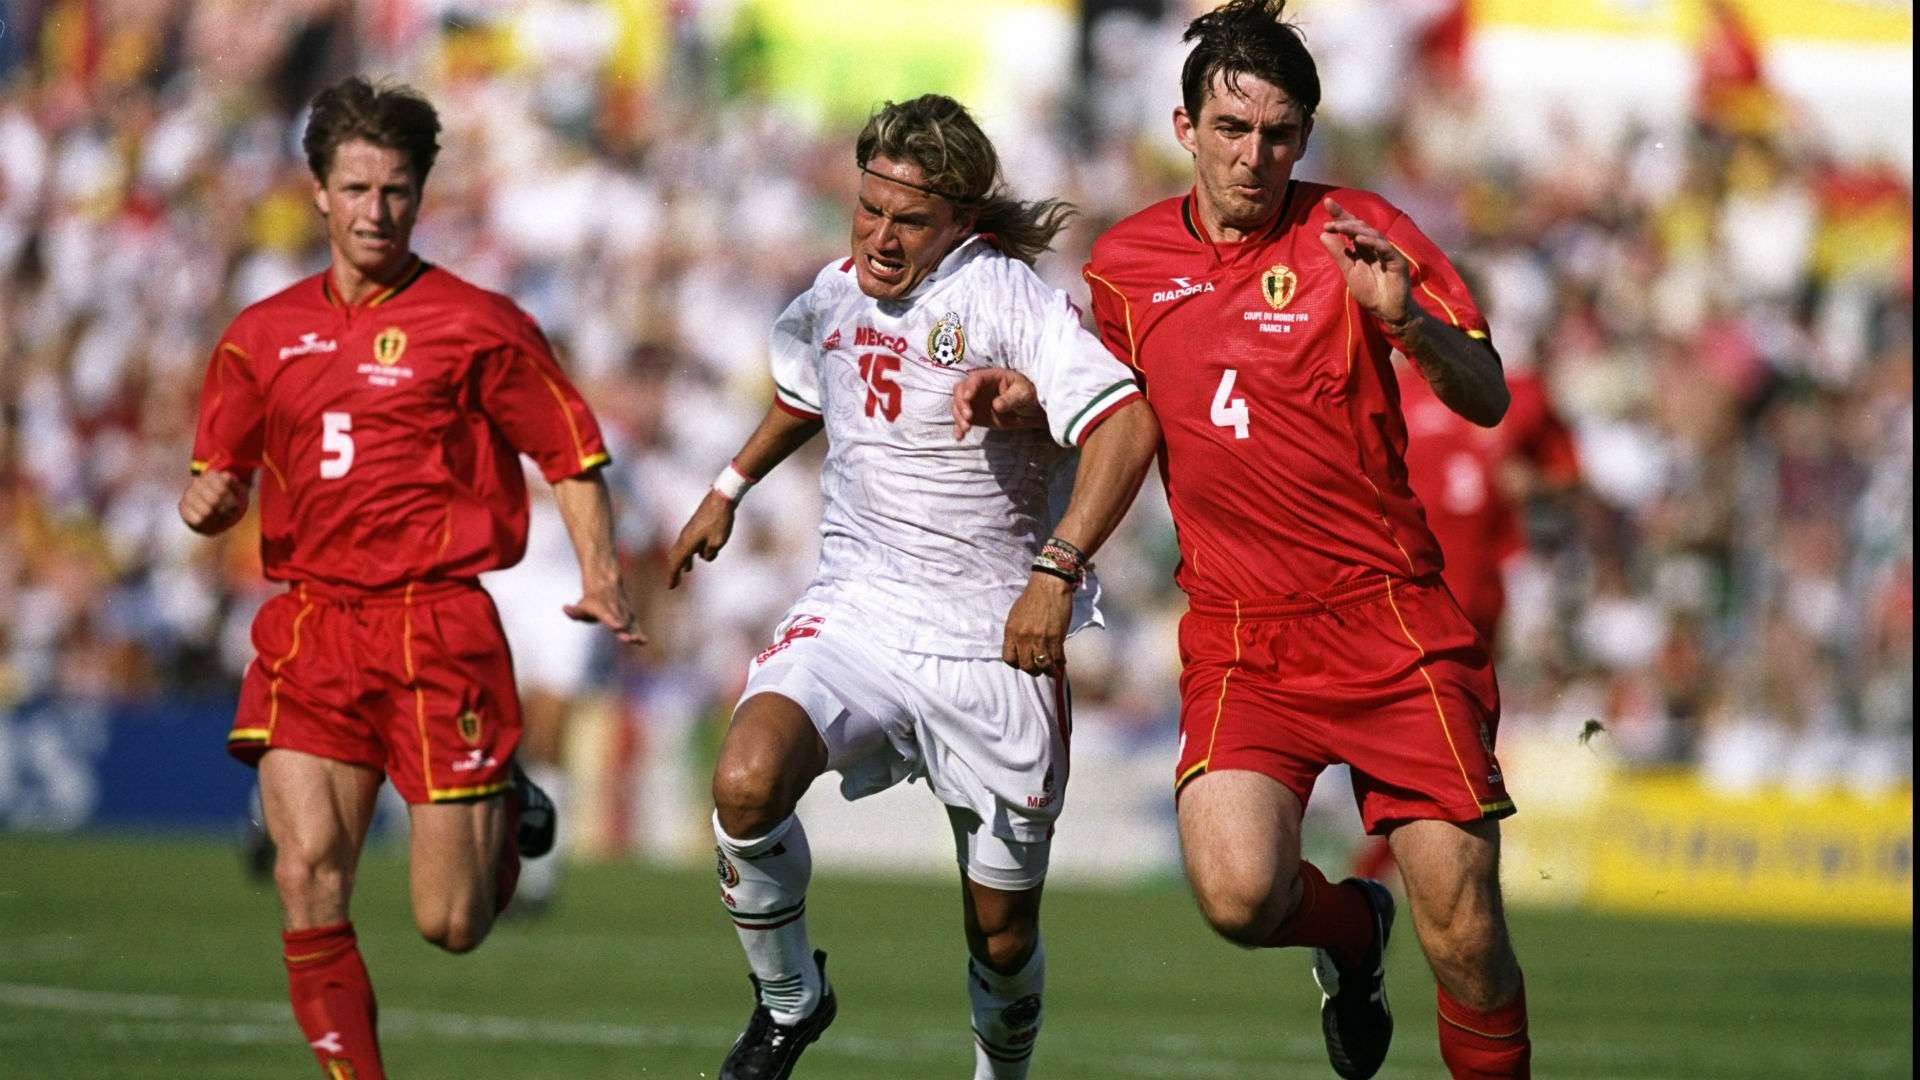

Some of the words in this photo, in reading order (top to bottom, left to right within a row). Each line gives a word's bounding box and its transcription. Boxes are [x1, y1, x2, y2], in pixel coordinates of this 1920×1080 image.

[1152, 282, 1215, 303] DIADORA
[1244, 311, 1262, 321] COUPE
[1263, 312, 1273, 321] DU
[1273, 313, 1295, 322] MONDE
[1295, 313, 1309, 322] FIFA
[1259, 323, 1282, 333] FRANCE
[853, 326, 908, 354] MEXICO
[858, 354, 902, 422] 15
[1210, 368, 1250, 440] 4
[320, 412, 355, 480] 5
